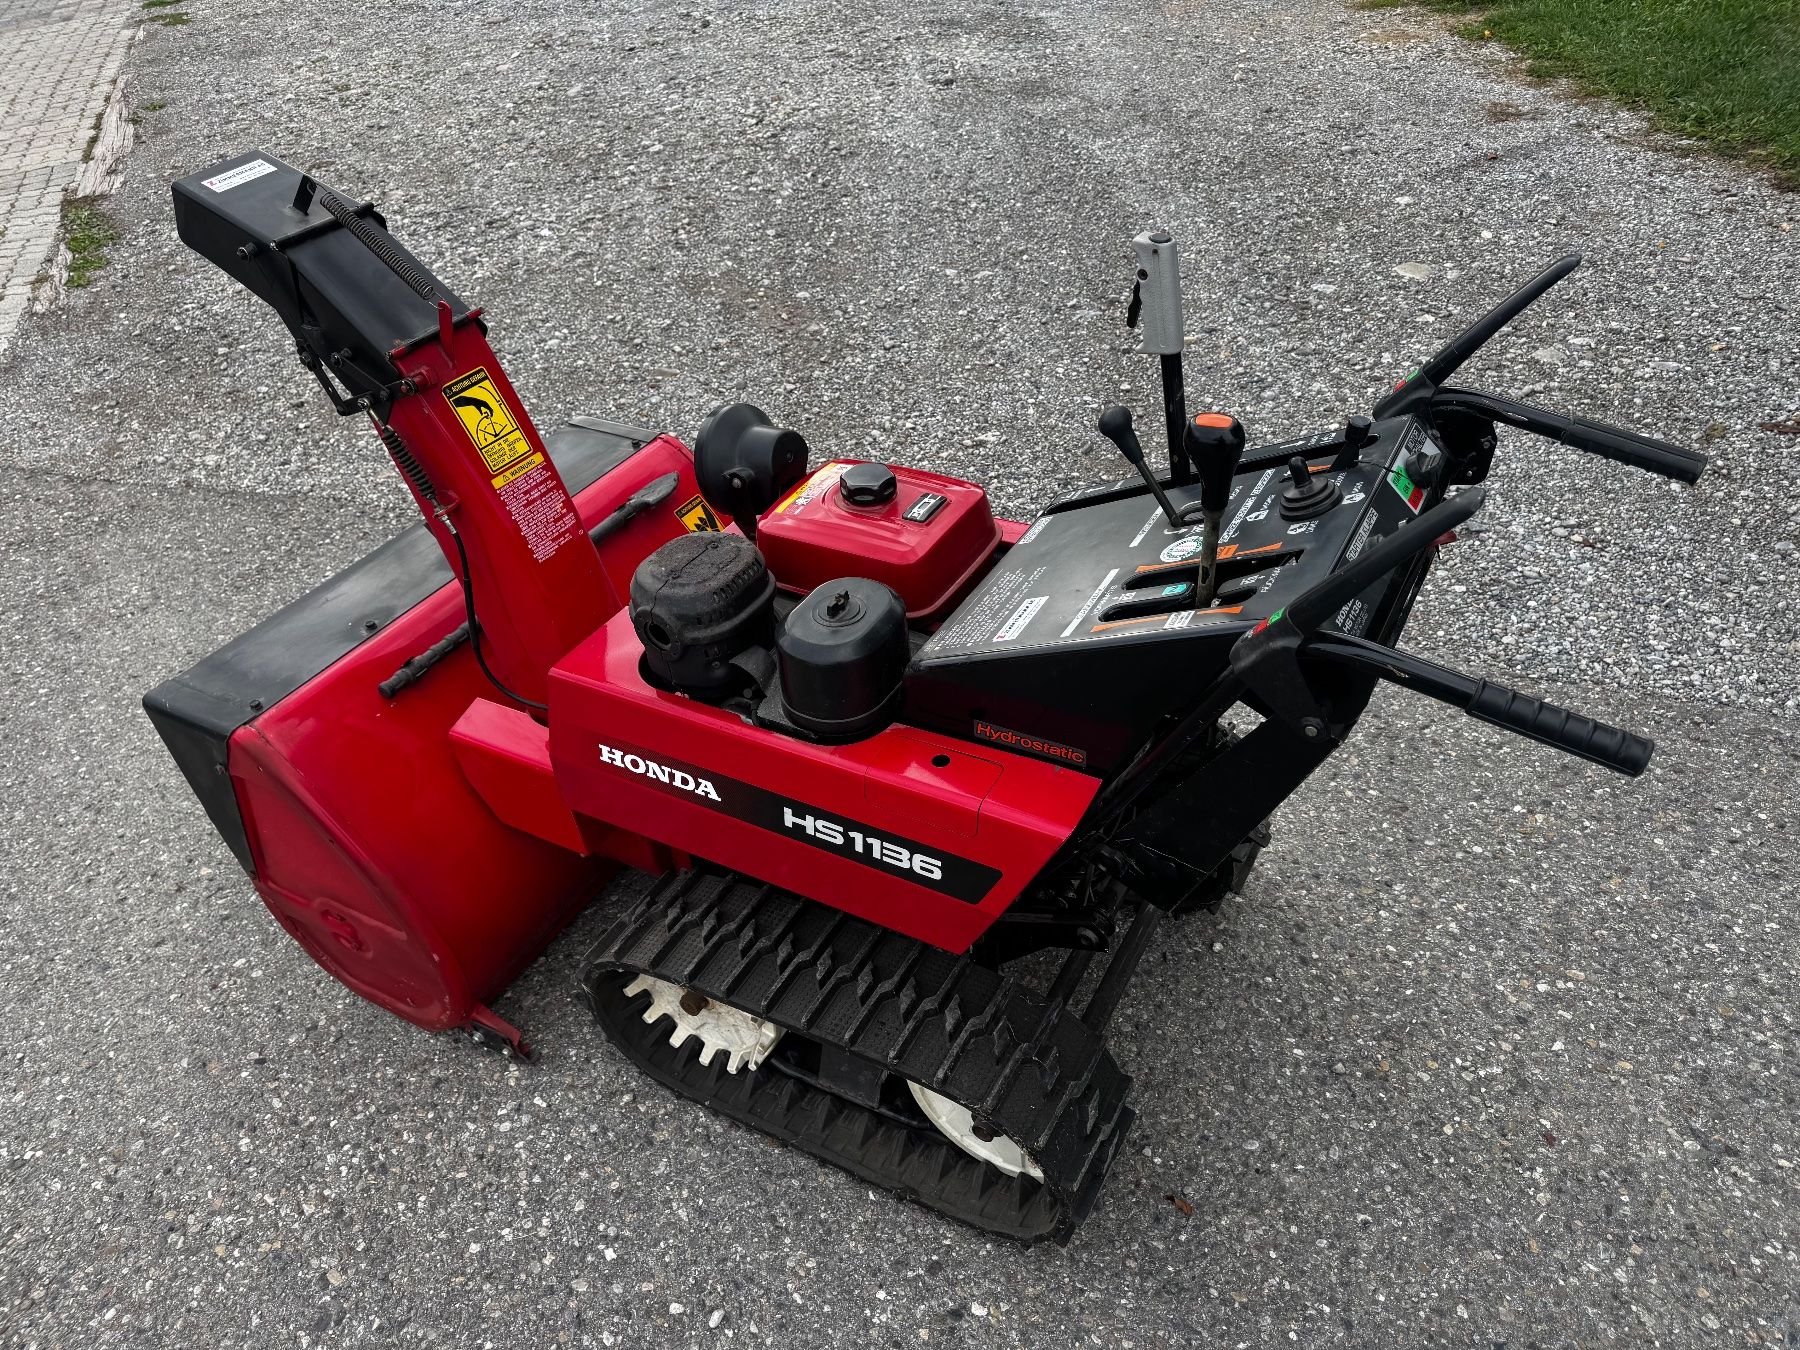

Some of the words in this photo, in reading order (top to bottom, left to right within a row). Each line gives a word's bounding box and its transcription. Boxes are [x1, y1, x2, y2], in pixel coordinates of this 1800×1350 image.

[509, 459, 536, 477] WARNUNG
[1347, 532, 1365, 560] STARTER
[1362, 509, 1378, 535] KLAPPE
[1342, 599, 1362, 633] HS1136
[977, 723, 1084, 763] Hydrostatic
[598, 744, 721, 801] HONDA
[783, 806, 942, 881] HS1136
